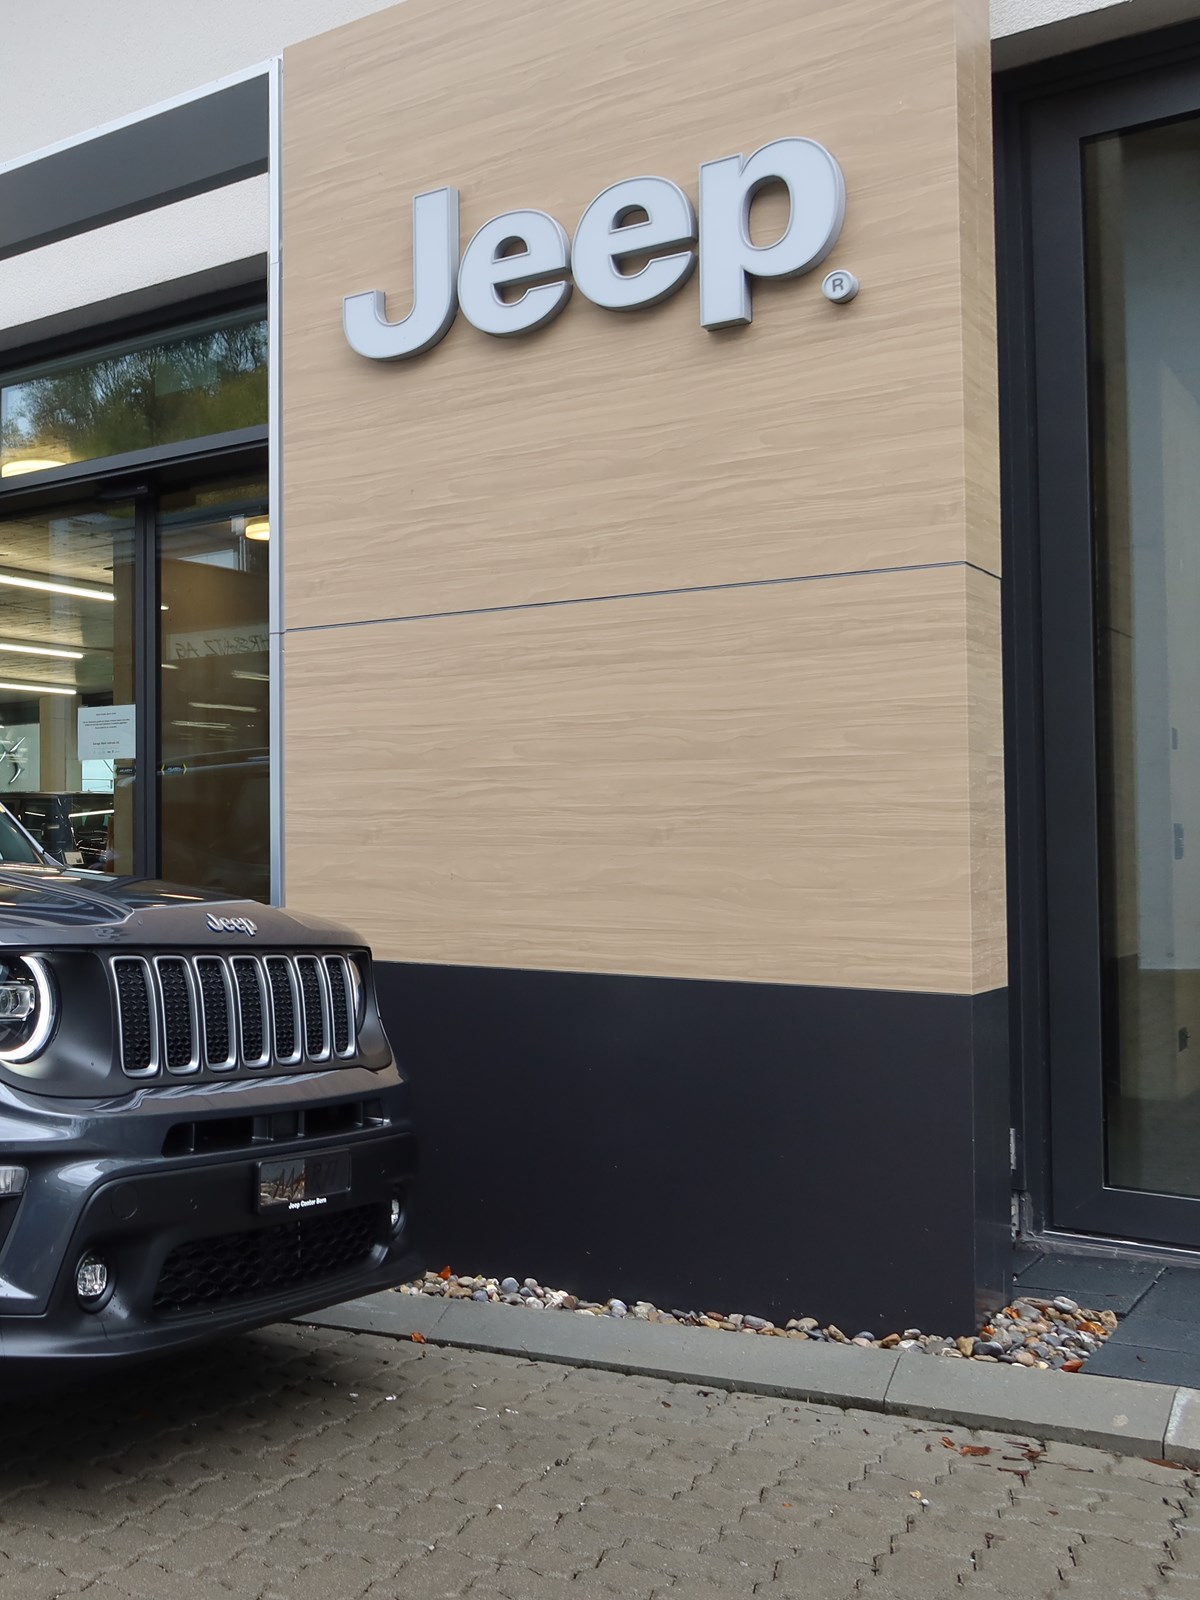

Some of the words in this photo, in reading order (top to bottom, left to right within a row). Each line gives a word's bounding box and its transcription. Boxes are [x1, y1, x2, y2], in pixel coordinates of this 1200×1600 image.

[342, 136, 847, 363] Jeep
[205, 912, 258, 937] Jeep
[288, 1201, 301, 1210] Jeep
[300, 1199, 316, 1208] Center
[316, 1197, 327, 1205] Bern
